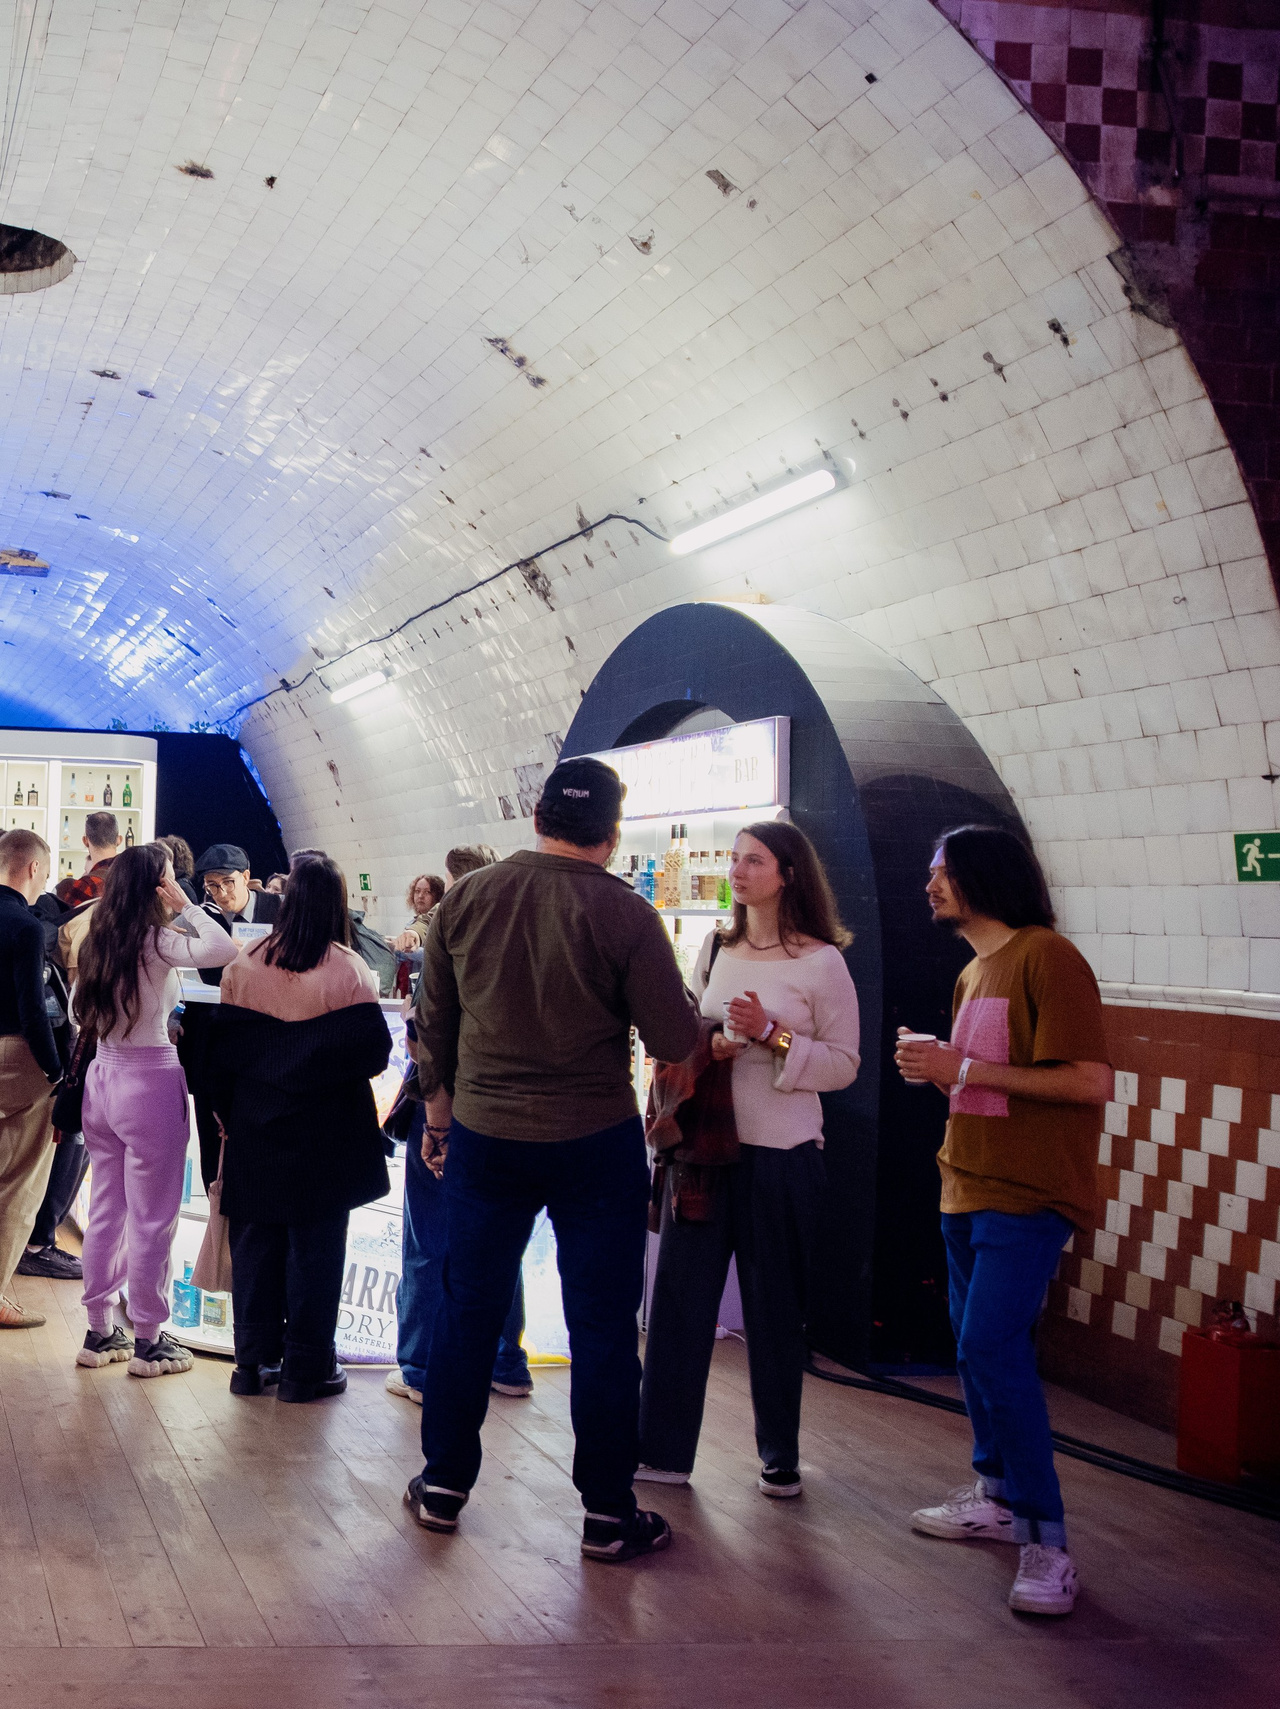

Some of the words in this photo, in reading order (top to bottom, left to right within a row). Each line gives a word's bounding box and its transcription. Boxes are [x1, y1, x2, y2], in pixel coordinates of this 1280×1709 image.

[734, 756, 758, 784] BAR
[562, 788, 590, 799] VENUM
[340, 1262, 400, 1315] ARR
[336, 1309, 394, 1338] DRY
[343, 1332, 394, 1350] MASTERLY
